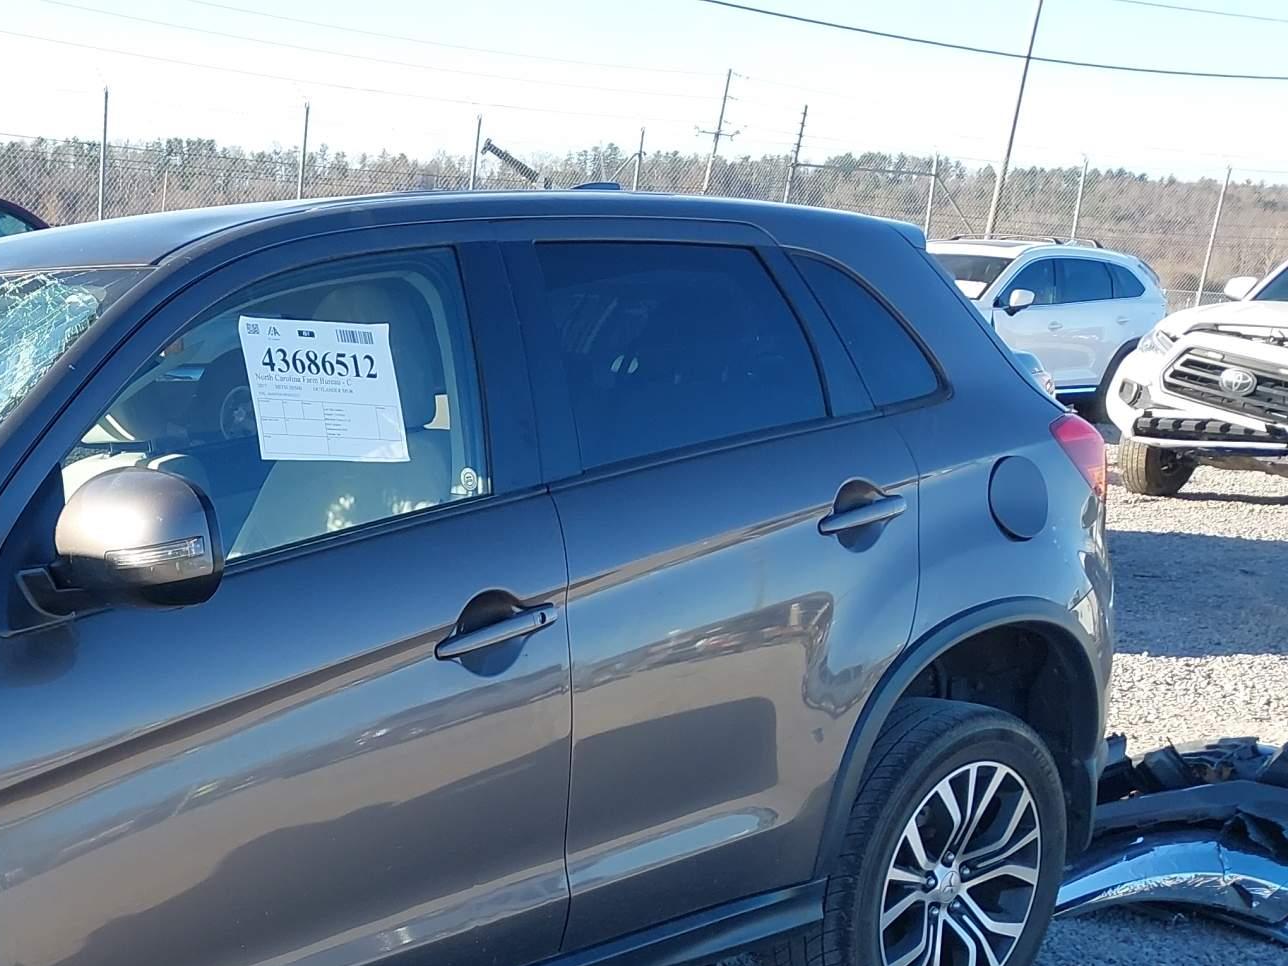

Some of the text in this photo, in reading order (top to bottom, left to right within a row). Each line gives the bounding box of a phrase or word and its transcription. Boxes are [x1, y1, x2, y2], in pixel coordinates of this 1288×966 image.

[262, 347, 378, 379] 43686512
[255, 373, 274, 382] North
[275, 375, 301, 383] Carolina
[303, 376, 318, 384] Farm
[320, 377, 341, 386] Bureau
